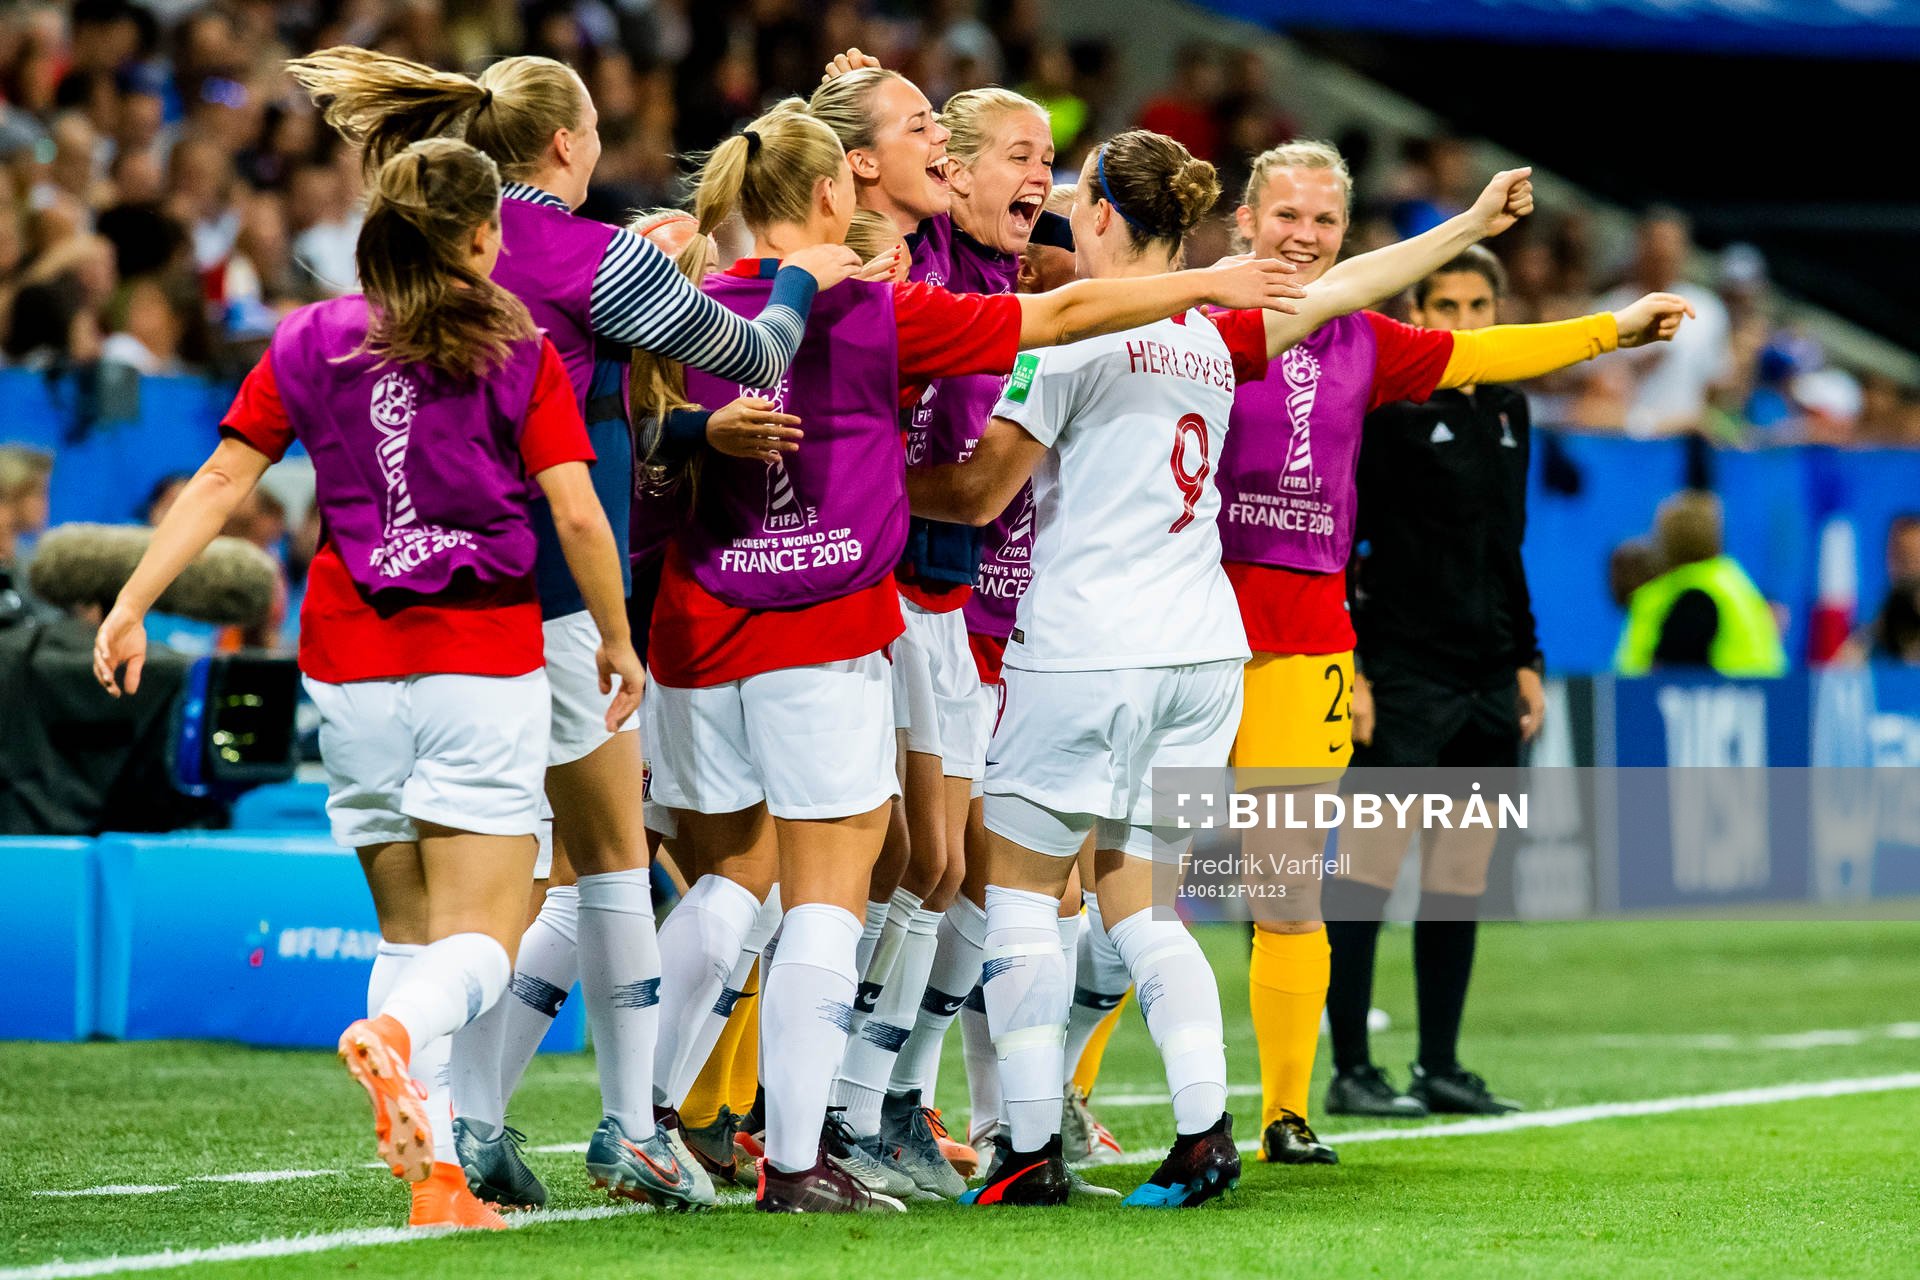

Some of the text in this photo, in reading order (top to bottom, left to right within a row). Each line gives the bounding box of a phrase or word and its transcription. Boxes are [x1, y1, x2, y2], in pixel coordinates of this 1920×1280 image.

[1126, 341, 1233, 393] HERLOVSE
[1168, 412, 1210, 534] 9
[1283, 475, 1308, 489] FIFA
[1238, 492, 1288, 507] WOMEN'S
[1290, 498, 1320, 512] WORLD
[770, 512, 800, 528] FIFA
[1228, 503, 1308, 530] FRANCE
[782, 532, 825, 548] WORLD
[828, 527, 851, 540] CUP
[720, 539, 862, 574] FRANCE 2019
[1003, 546, 1028, 558] FIFA
[978, 562, 1009, 577] MEN'S
[971, 574, 1029, 599] ANCE
[1324, 663, 1354, 723] 2
